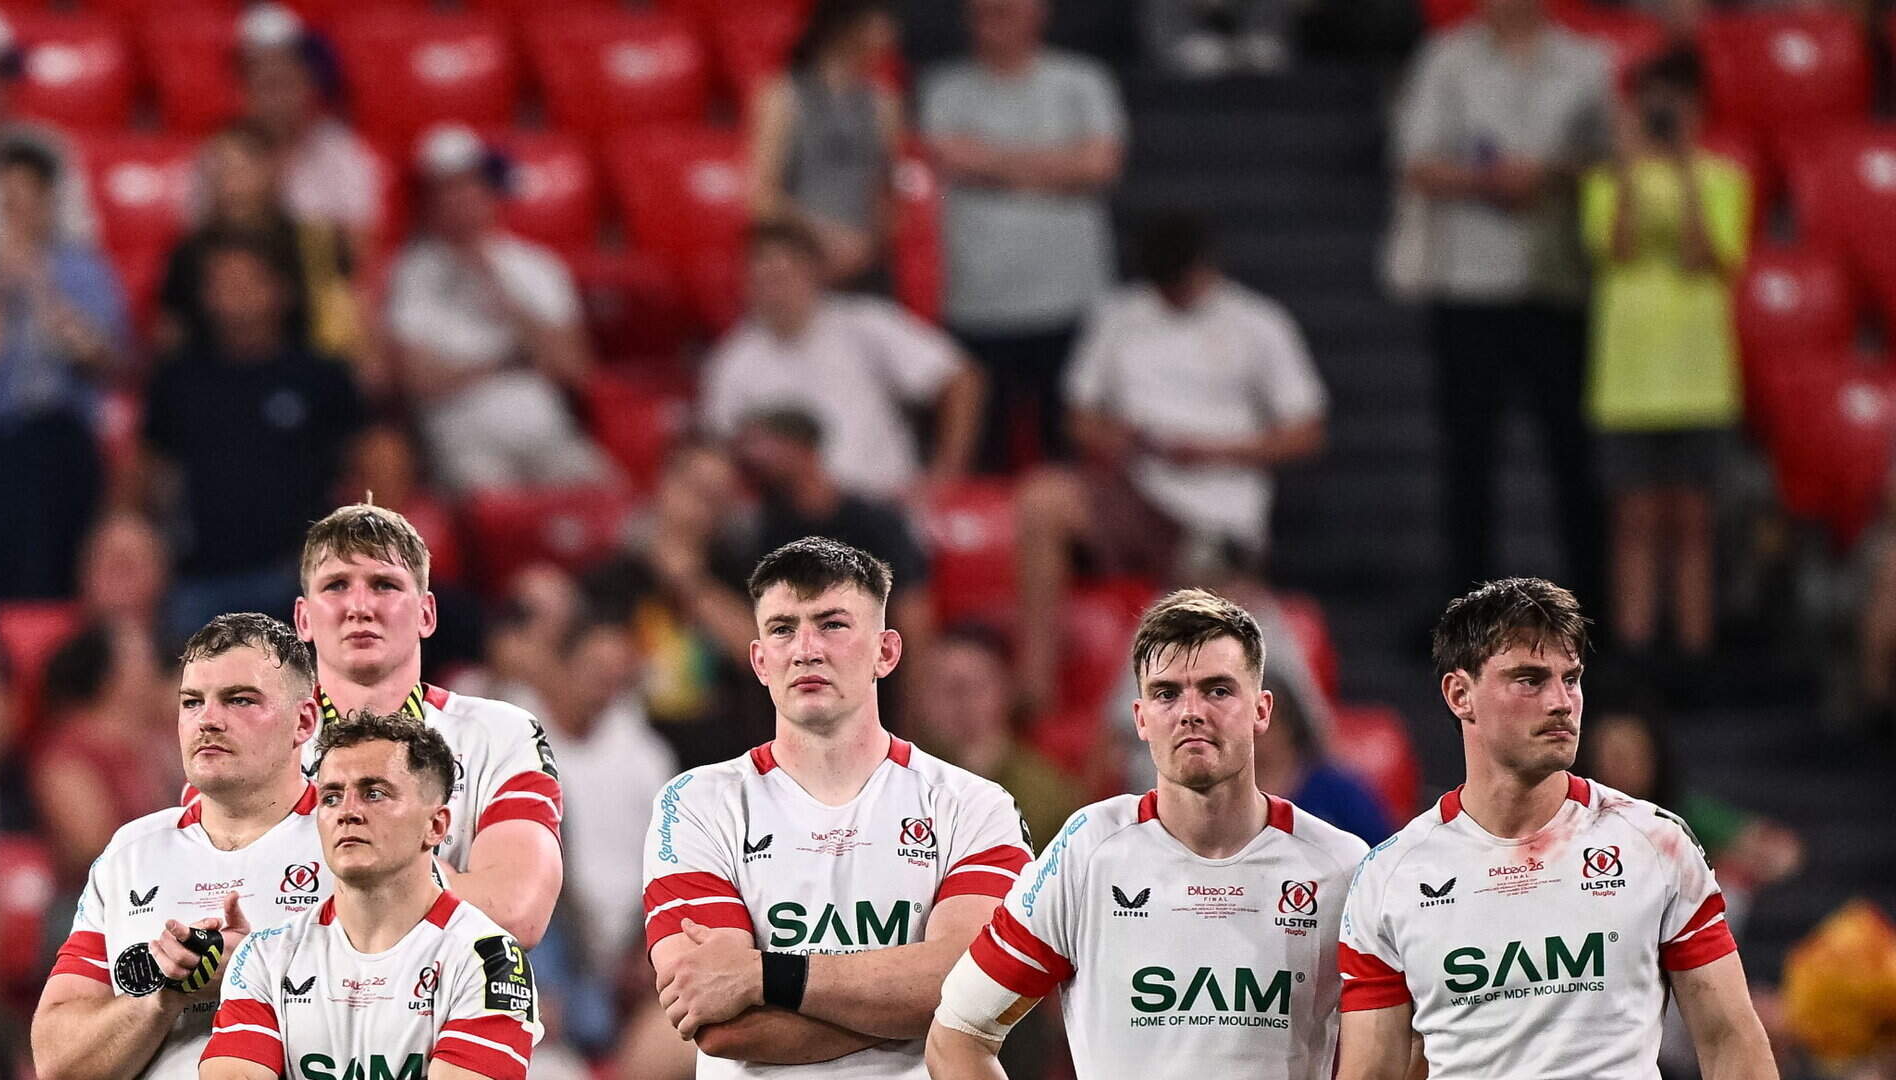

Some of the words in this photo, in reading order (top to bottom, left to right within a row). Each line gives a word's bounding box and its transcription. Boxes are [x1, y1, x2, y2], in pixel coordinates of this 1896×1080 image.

[1488, 865, 1528, 877] Bilbao
[1529, 860, 1544, 872] 26
[1187, 885, 1226, 896] Bilbao
[1228, 886, 1245, 896] 26
[1580, 879, 1626, 891] ULSTER
[1592, 889, 1617, 898] Rugby
[1275, 916, 1317, 930] ULSTER
[1284, 927, 1307, 937] Rugby
[1450, 994, 1481, 1008] HOME
[1484, 991, 1501, 1003] OF
[1504, 988, 1531, 1000] MDF
[1534, 980, 1605, 997] MOULDINGS
[510, 998, 531, 1011] CUP
[1131, 1016, 1166, 1028] HOME
[1169, 1015, 1185, 1026] OF
[1189, 1015, 1216, 1026] MDF
[1219, 1016, 1289, 1029] MOULDINGS
